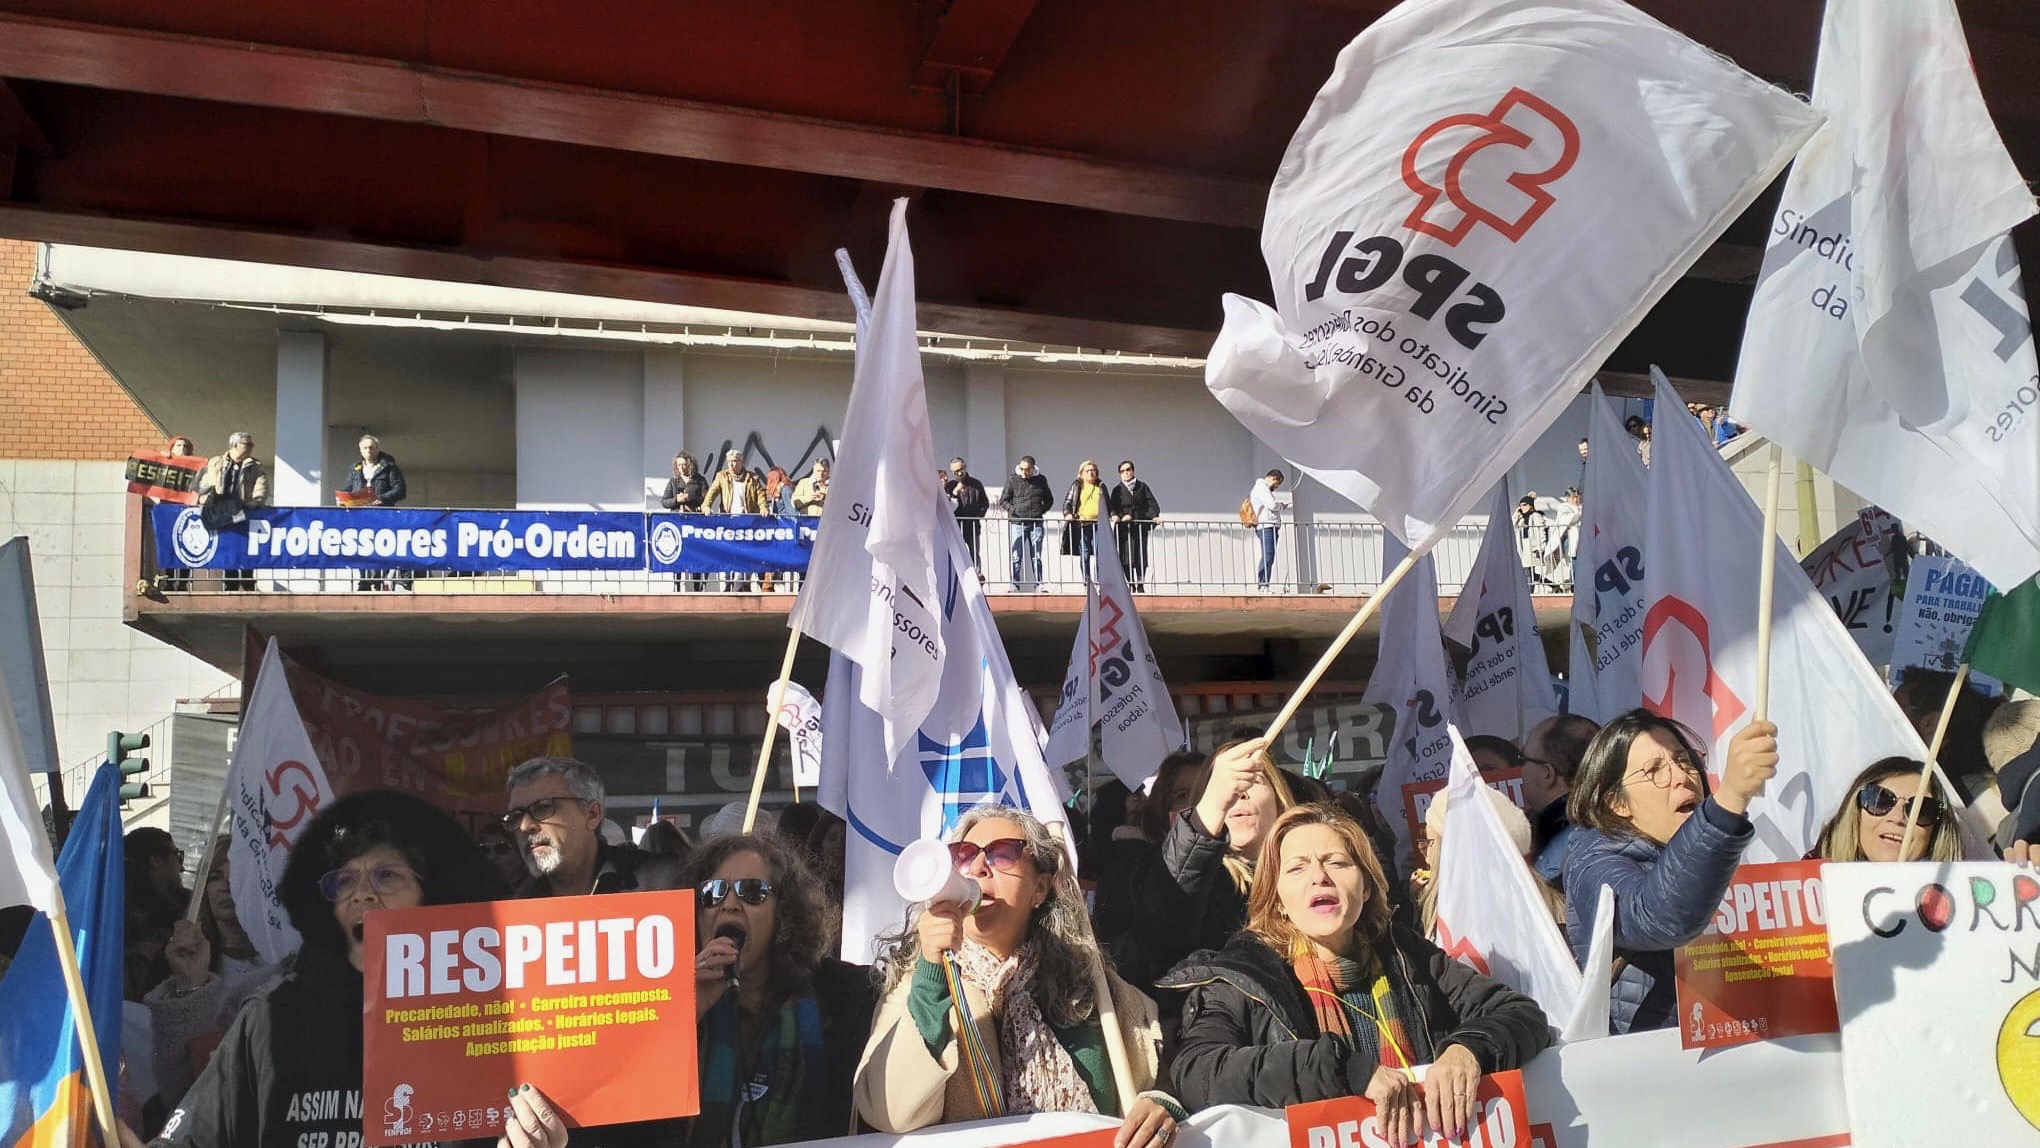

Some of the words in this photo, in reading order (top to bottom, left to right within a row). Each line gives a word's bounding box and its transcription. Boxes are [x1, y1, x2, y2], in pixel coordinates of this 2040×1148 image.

[248, 519, 447, 557] Professores
[457, 519, 635, 559] Pró-Ordem
[681, 524, 794, 541] Professores
[1915, 594, 1940, 606] PARA
[1704, 877, 1827, 935] SPEITO
[386, 915, 675, 998] RESPEITO
[385, 1001, 483, 1023] Precariedade,
[484, 999, 515, 1016] não!
[531, 995, 588, 1013] Carreira
[590, 988, 672, 1008] recomposta.
[402, 1019, 460, 1043] Salários
[462, 1017, 545, 1038] atualizados.
[555, 1010, 613, 1030] Horários
[615, 1008, 659, 1025] legais.
[465, 1036, 555, 1058] Aposentação
[557, 1031, 597, 1051] justa!
[286, 1091, 339, 1122] ASSIM
